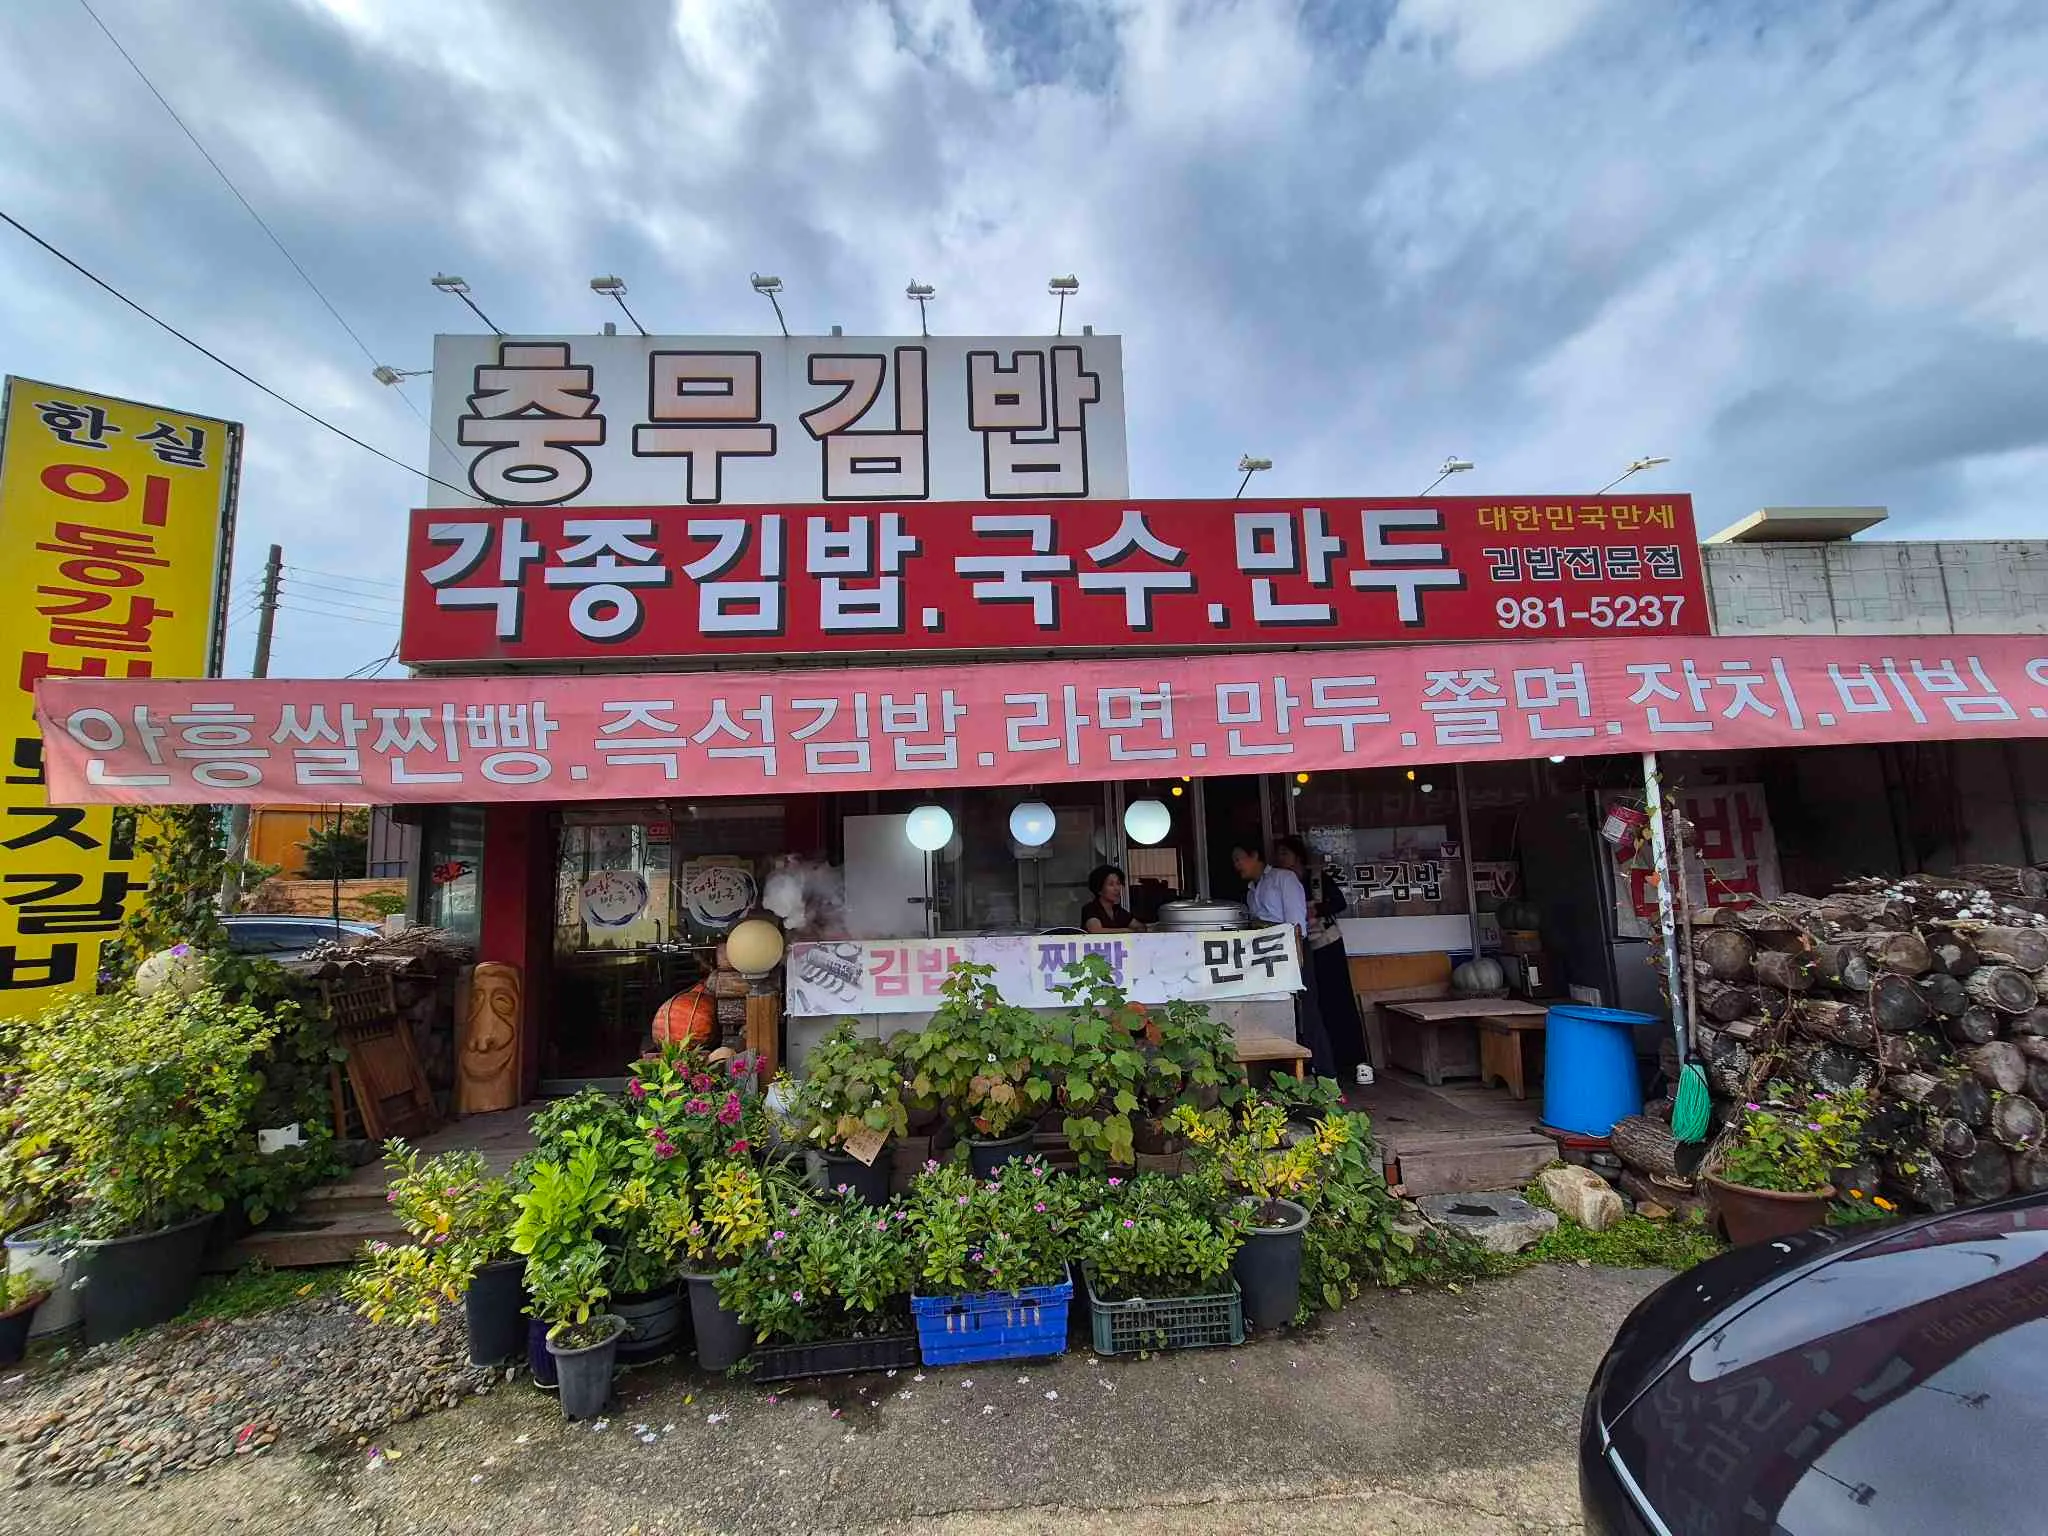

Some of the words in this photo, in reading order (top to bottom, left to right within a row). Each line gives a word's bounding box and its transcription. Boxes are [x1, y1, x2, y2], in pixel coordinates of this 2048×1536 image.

[457, 341, 1101, 506] 충무김밥
[1477, 504, 1675, 532] 대한민국만세
[1482, 544, 1684, 582] 김밥전문점
[1495, 594, 1686, 630] 981-5237
[0, 736, 149, 996] 지갈비
[869, 944, 962, 997] 김밥
[1203, 930, 1291, 984] 만두
